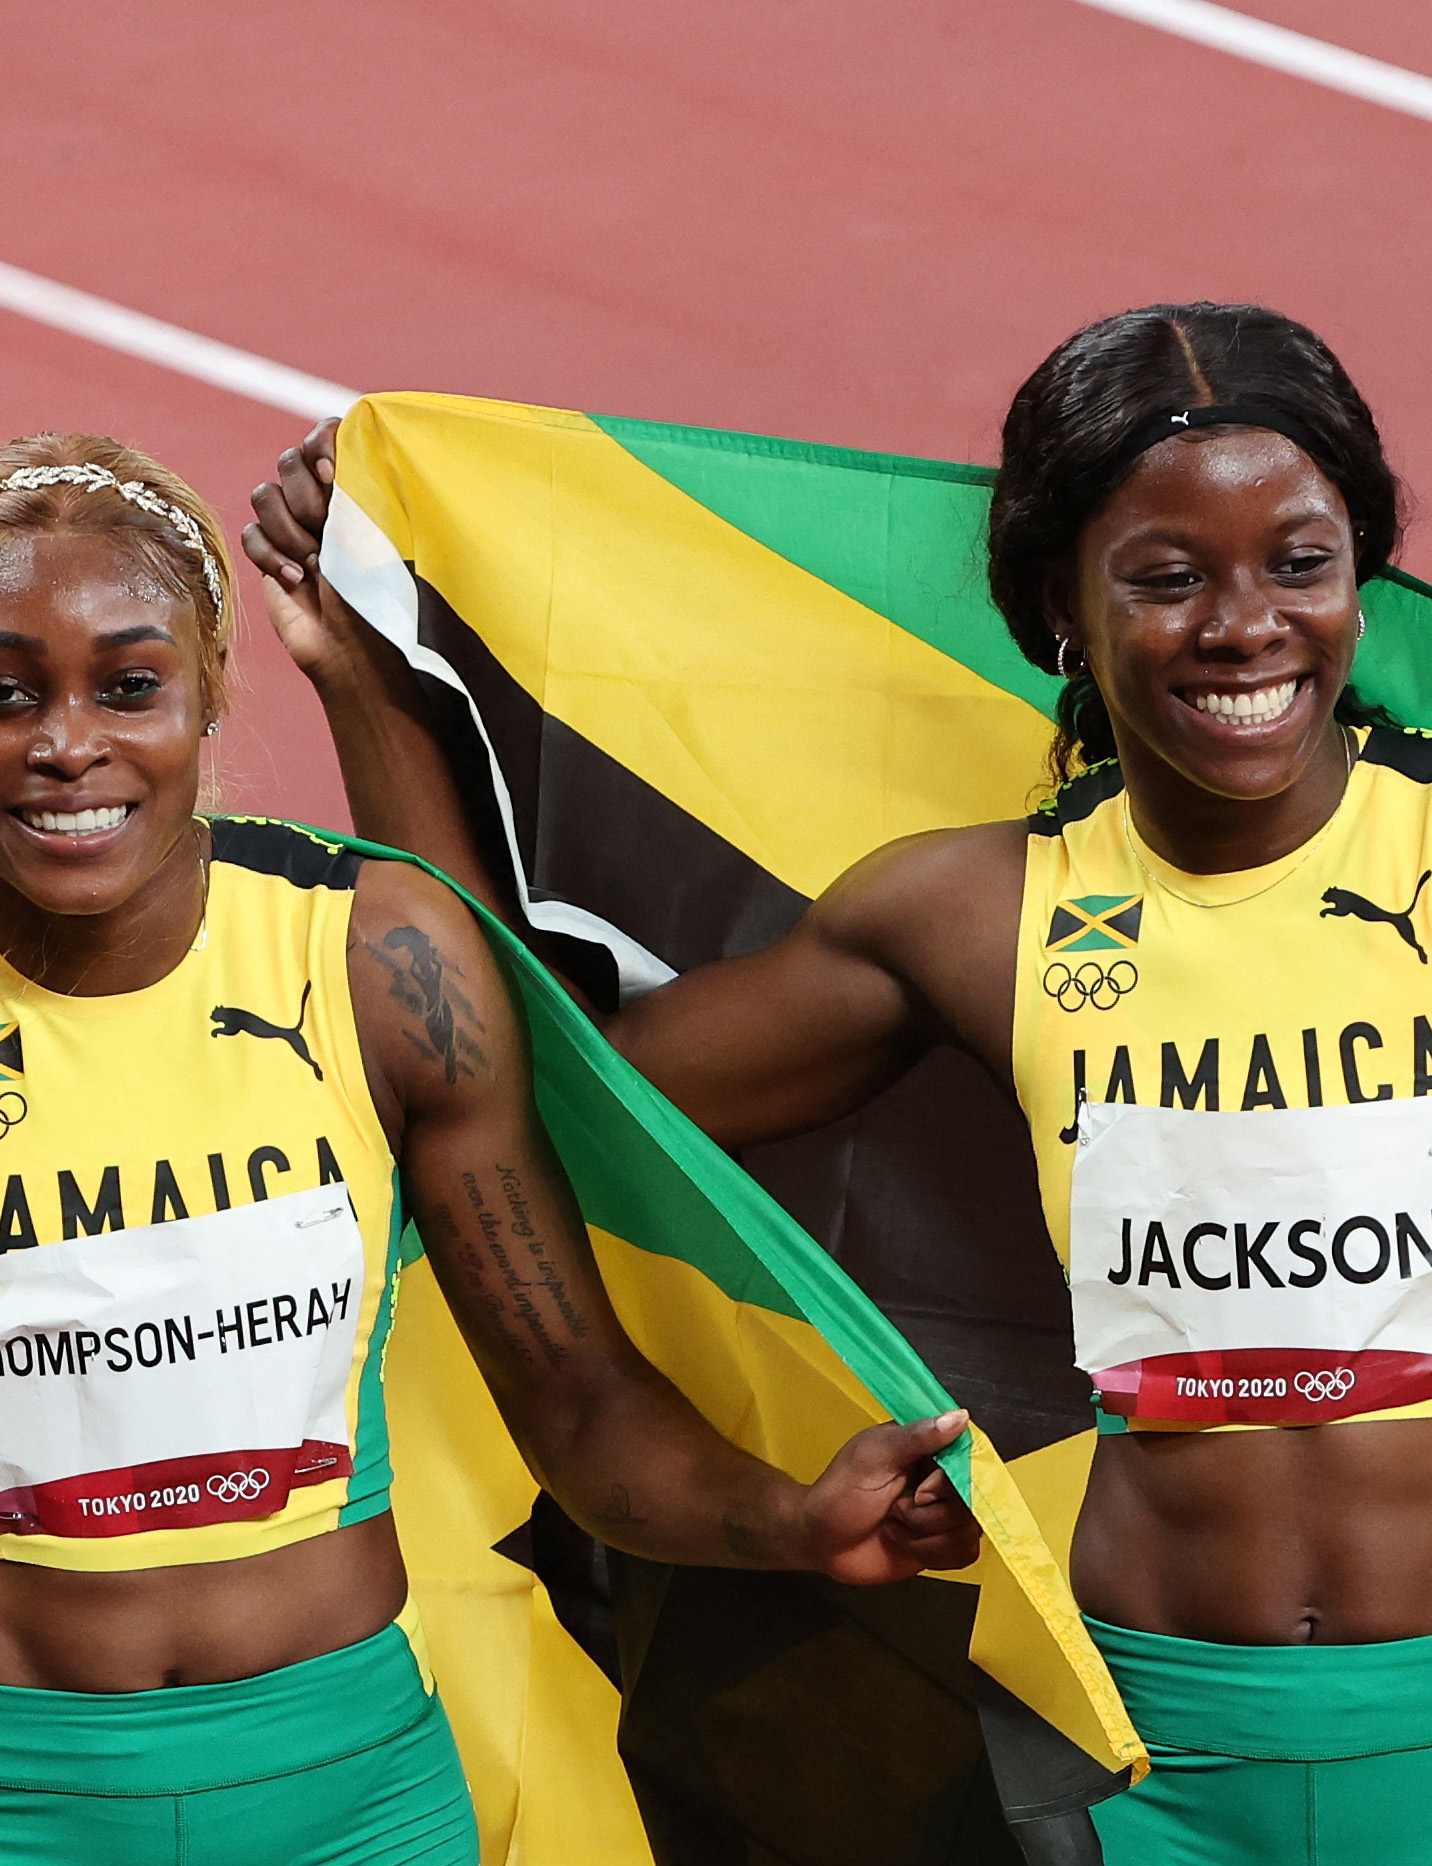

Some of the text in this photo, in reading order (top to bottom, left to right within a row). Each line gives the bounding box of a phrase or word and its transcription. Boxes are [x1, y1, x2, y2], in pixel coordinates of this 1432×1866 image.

[495, 1163, 535, 1238] Nothing
[1176, 1377, 1287, 1398] TOKYO 2020
[78, 1484, 200, 1516] TOKYO 2020
